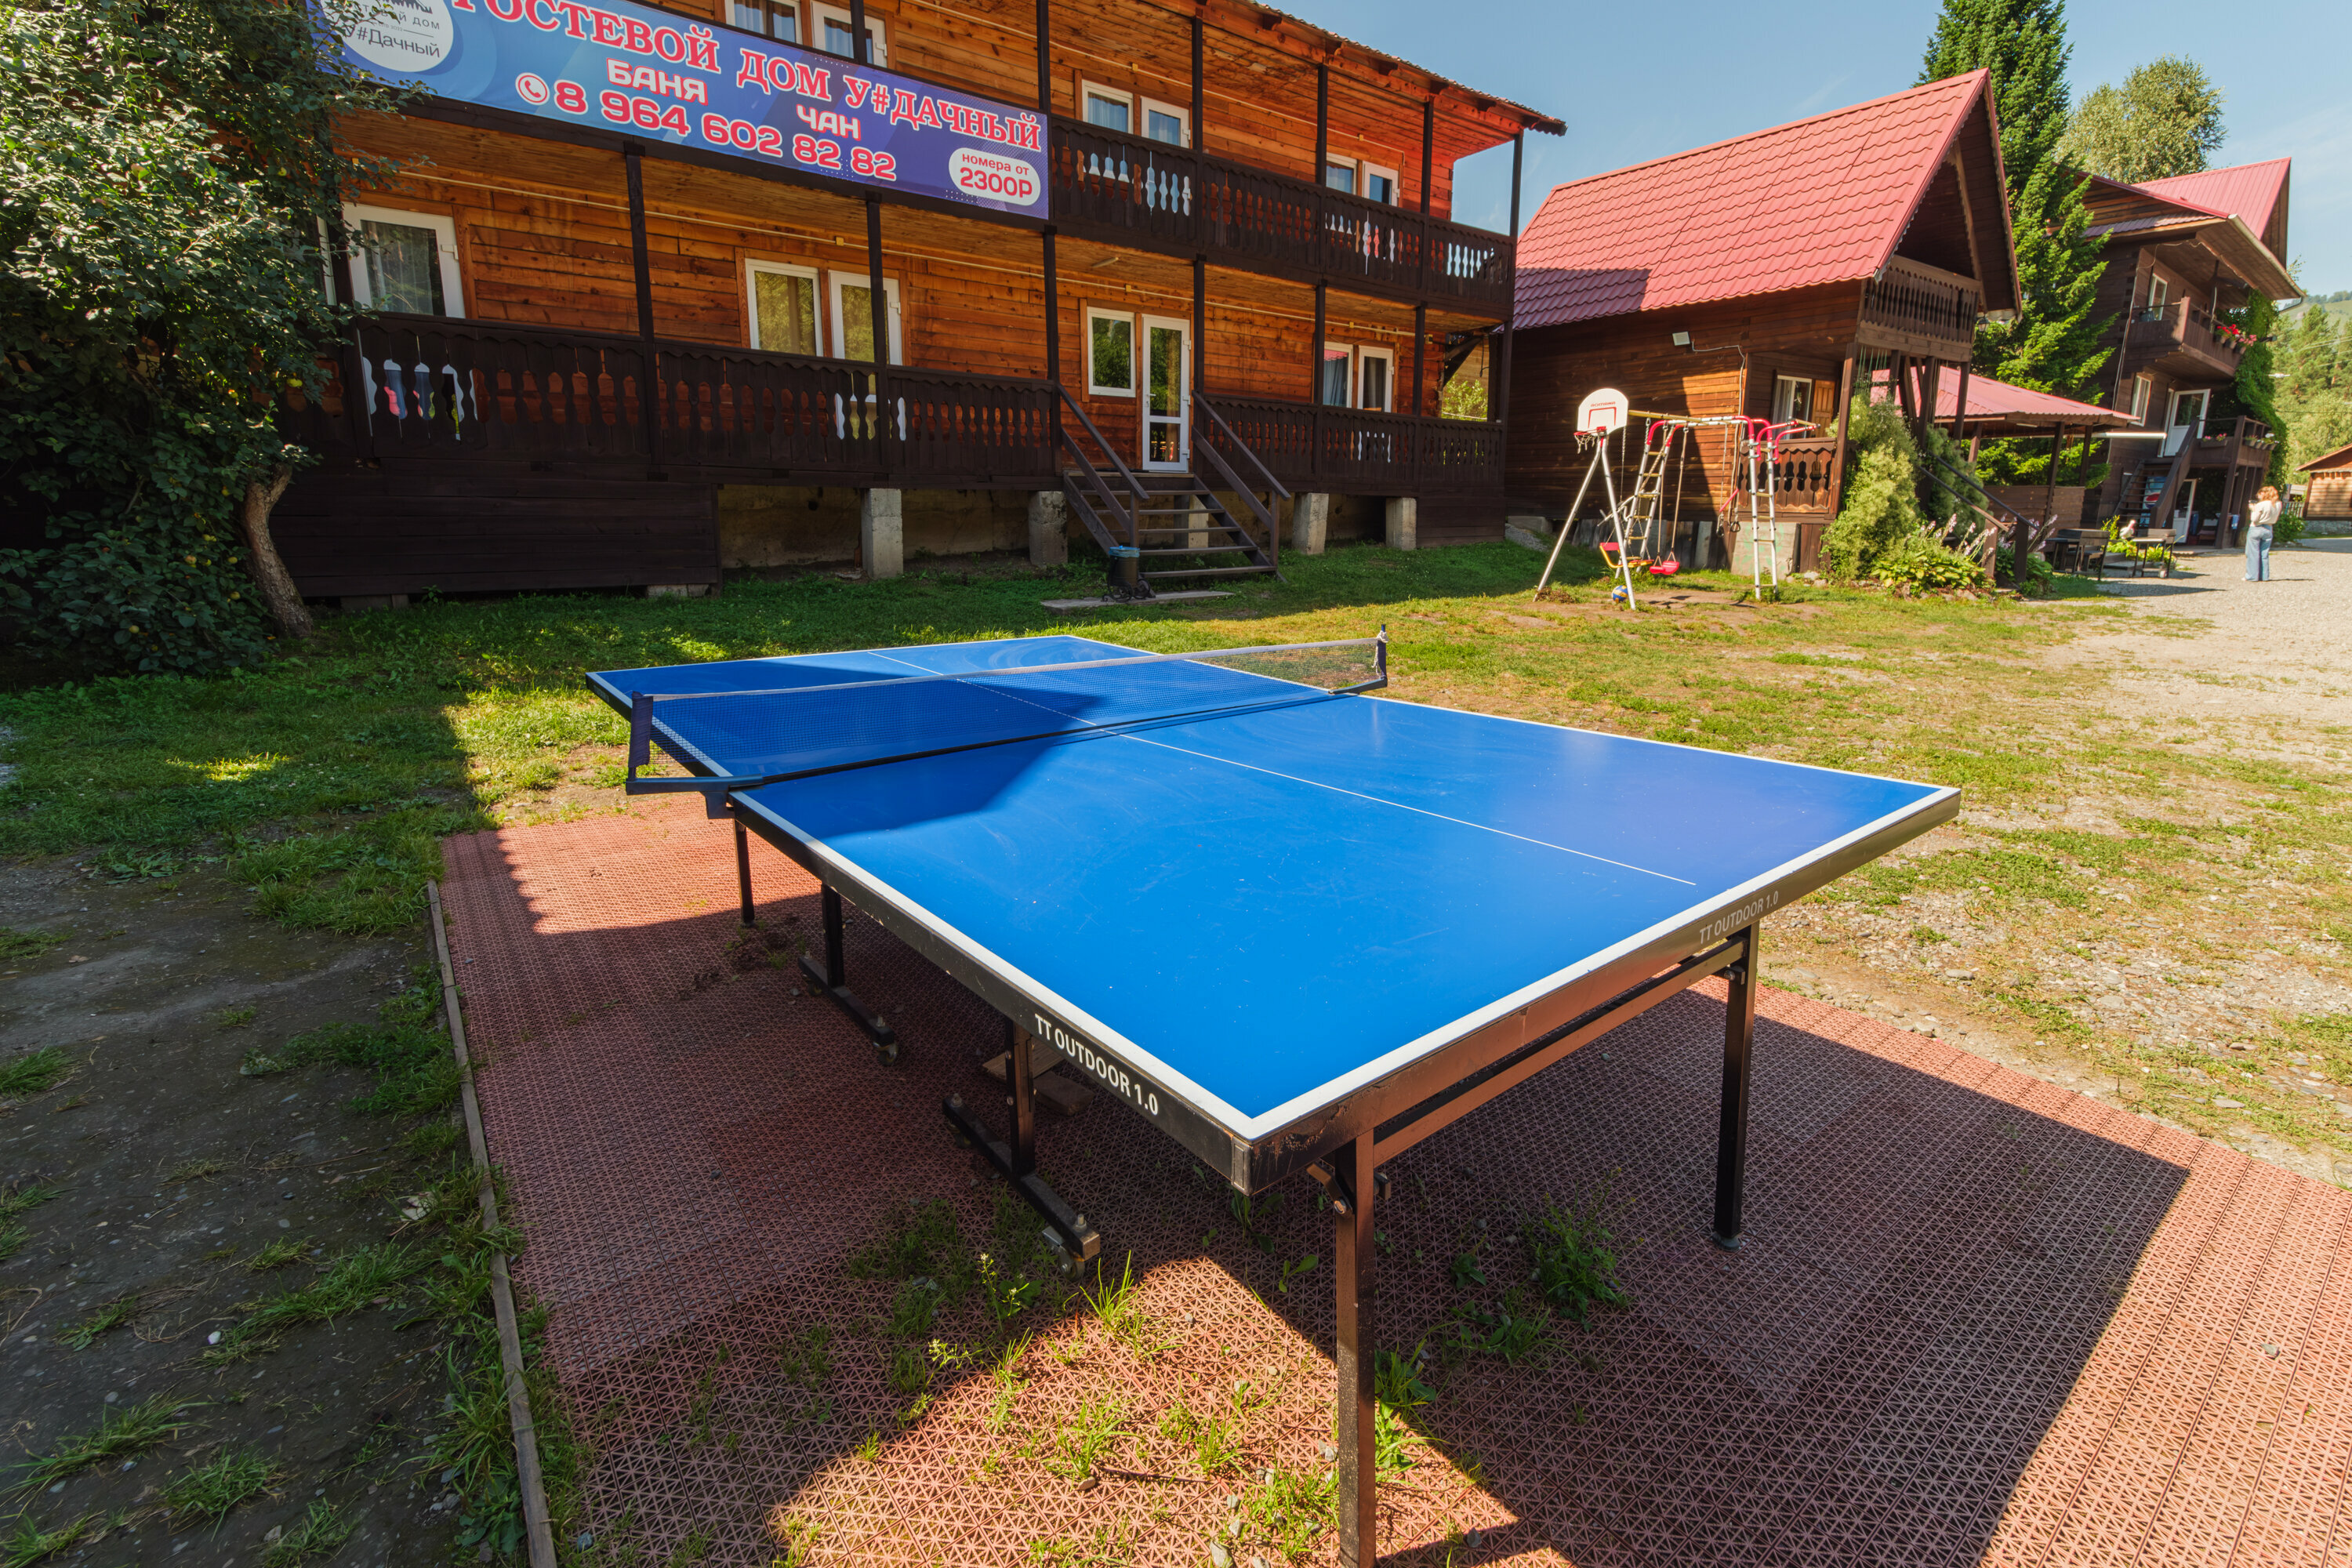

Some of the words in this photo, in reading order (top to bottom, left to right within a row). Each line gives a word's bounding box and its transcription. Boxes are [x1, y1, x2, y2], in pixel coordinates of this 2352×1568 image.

[413, 16, 439, 30] ДОМ
[452, 0, 720, 73] ОСТЕВОЙ
[738, 49, 830, 100] ДОМ
[844, 75, 1040, 151] У#ДАЧНЫЙ
[607, 58, 708, 106] БАНЯ
[554, 79, 587, 115] 8
[601, 89, 690, 136] 964
[702, 113, 783, 158] 602
[793, 134, 841, 170] 82
[851, 147, 896, 181] 82
[797, 104, 861, 141] ЧАН
[960, 167, 1033, 198] 2300Р
[962, 154, 1011, 172] номера
[1015, 165, 1029, 176] от
[1700, 924, 1713, 944] TT
[1715, 898, 1763, 936] OUTDOOR
[1766, 891, 1778, 909] 1.0
[1035, 1013, 1051, 1040] TT
[1054, 1029, 1131, 1097] OUTDOOR
[1134, 1084, 1158, 1115] 1.0
